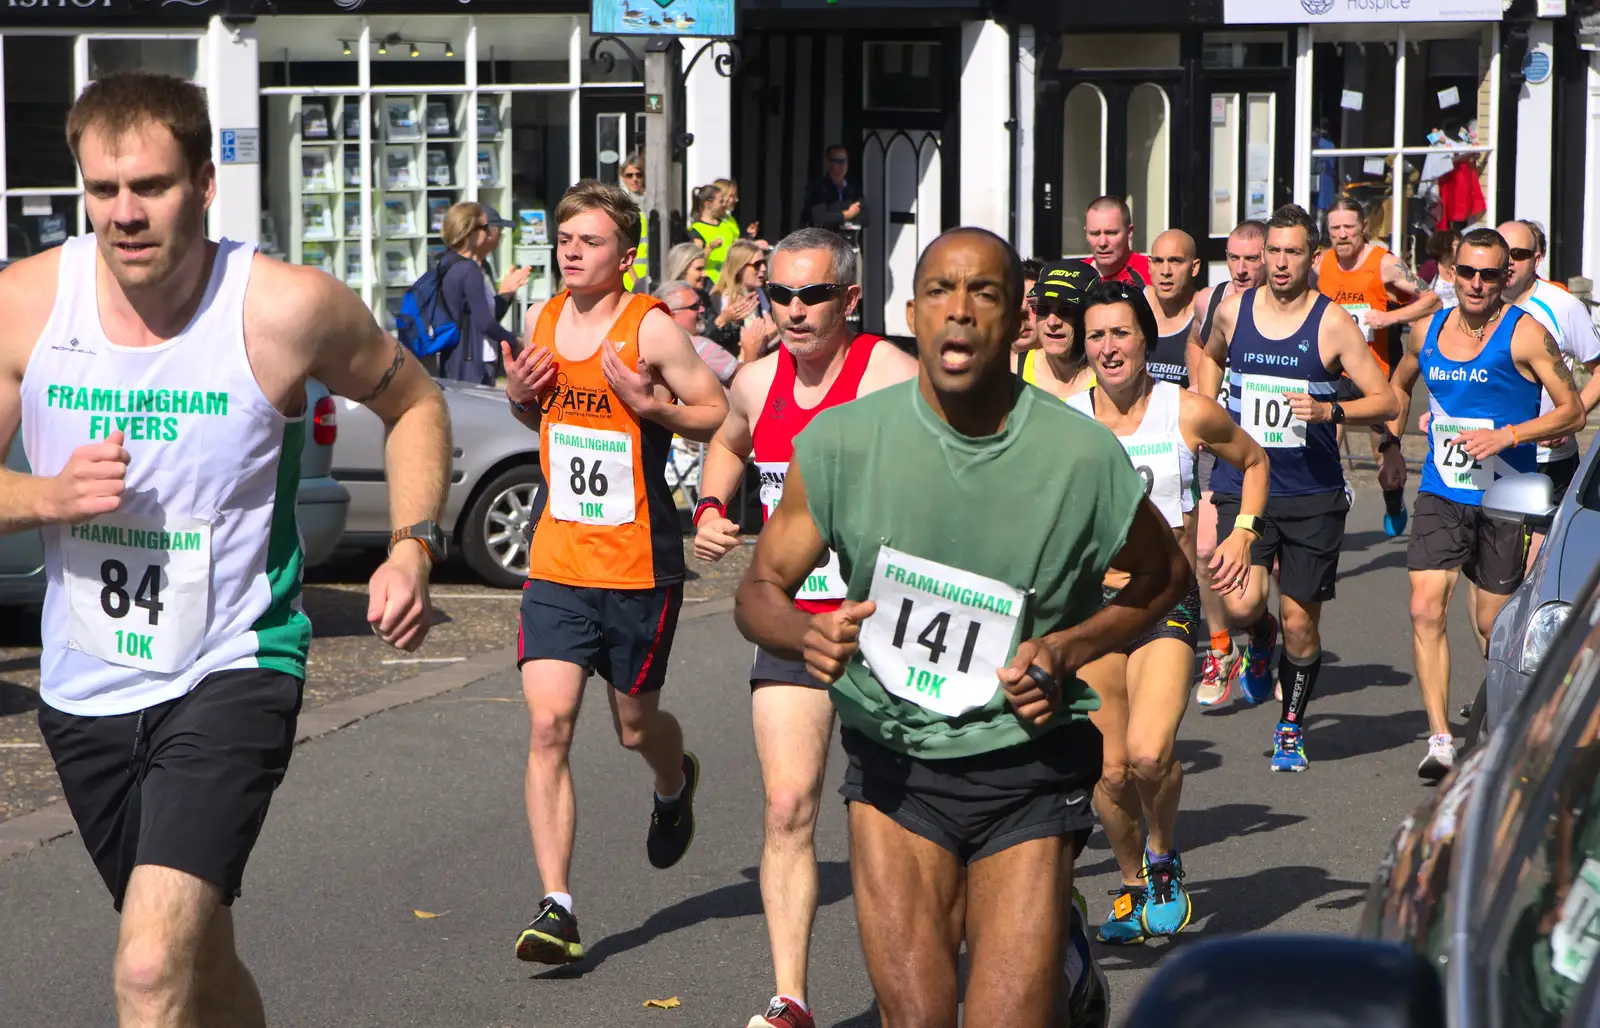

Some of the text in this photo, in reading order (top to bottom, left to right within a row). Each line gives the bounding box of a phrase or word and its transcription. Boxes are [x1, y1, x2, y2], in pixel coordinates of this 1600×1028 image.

[1243, 352, 1299, 367] IPSWICH
[1246, 382, 1305, 394] FRAMLINGHAM
[1469, 369, 1488, 383] AC
[47, 384, 228, 416] FRAMLINGHAM
[1254, 398, 1294, 428] 107
[89, 415, 178, 441] FLYERS
[1264, 431, 1284, 443] 10K
[554, 432, 627, 453] FRAMLINGHAM
[569, 456, 609, 497] 86
[1453, 472, 1472, 485] 10K
[579, 501, 604, 518] 10K
[70, 523, 201, 551] FRAMLINGHAM
[100, 559, 164, 626] 84
[884, 563, 1013, 616] FRAMLINGHAM
[114, 630, 154, 660] 10K
[892, 597, 982, 674] 141
[905, 665, 948, 699] 10K
